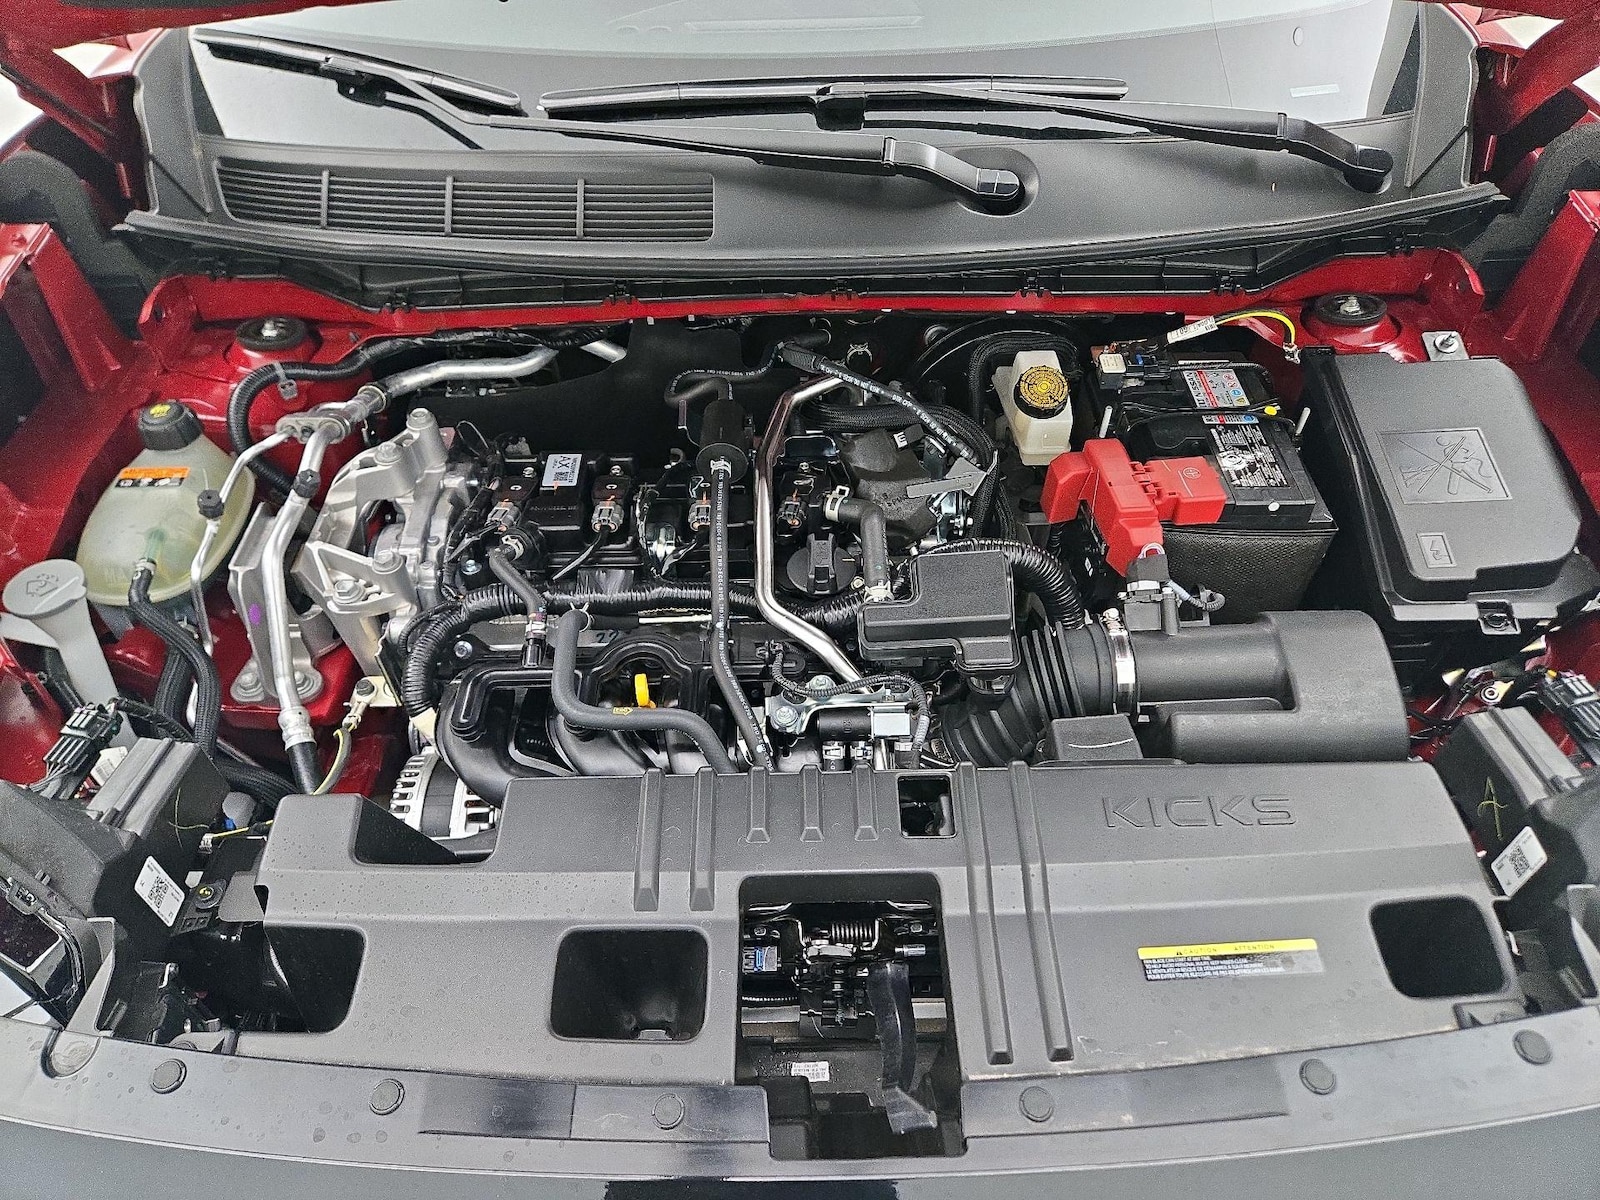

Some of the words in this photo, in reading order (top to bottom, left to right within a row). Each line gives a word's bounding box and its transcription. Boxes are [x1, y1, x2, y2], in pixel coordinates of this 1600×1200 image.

[1101, 794, 1296, 828] KICKS
[1183, 947, 1217, 955] CAUTION
[1234, 944, 1275, 952] ATTENTION
